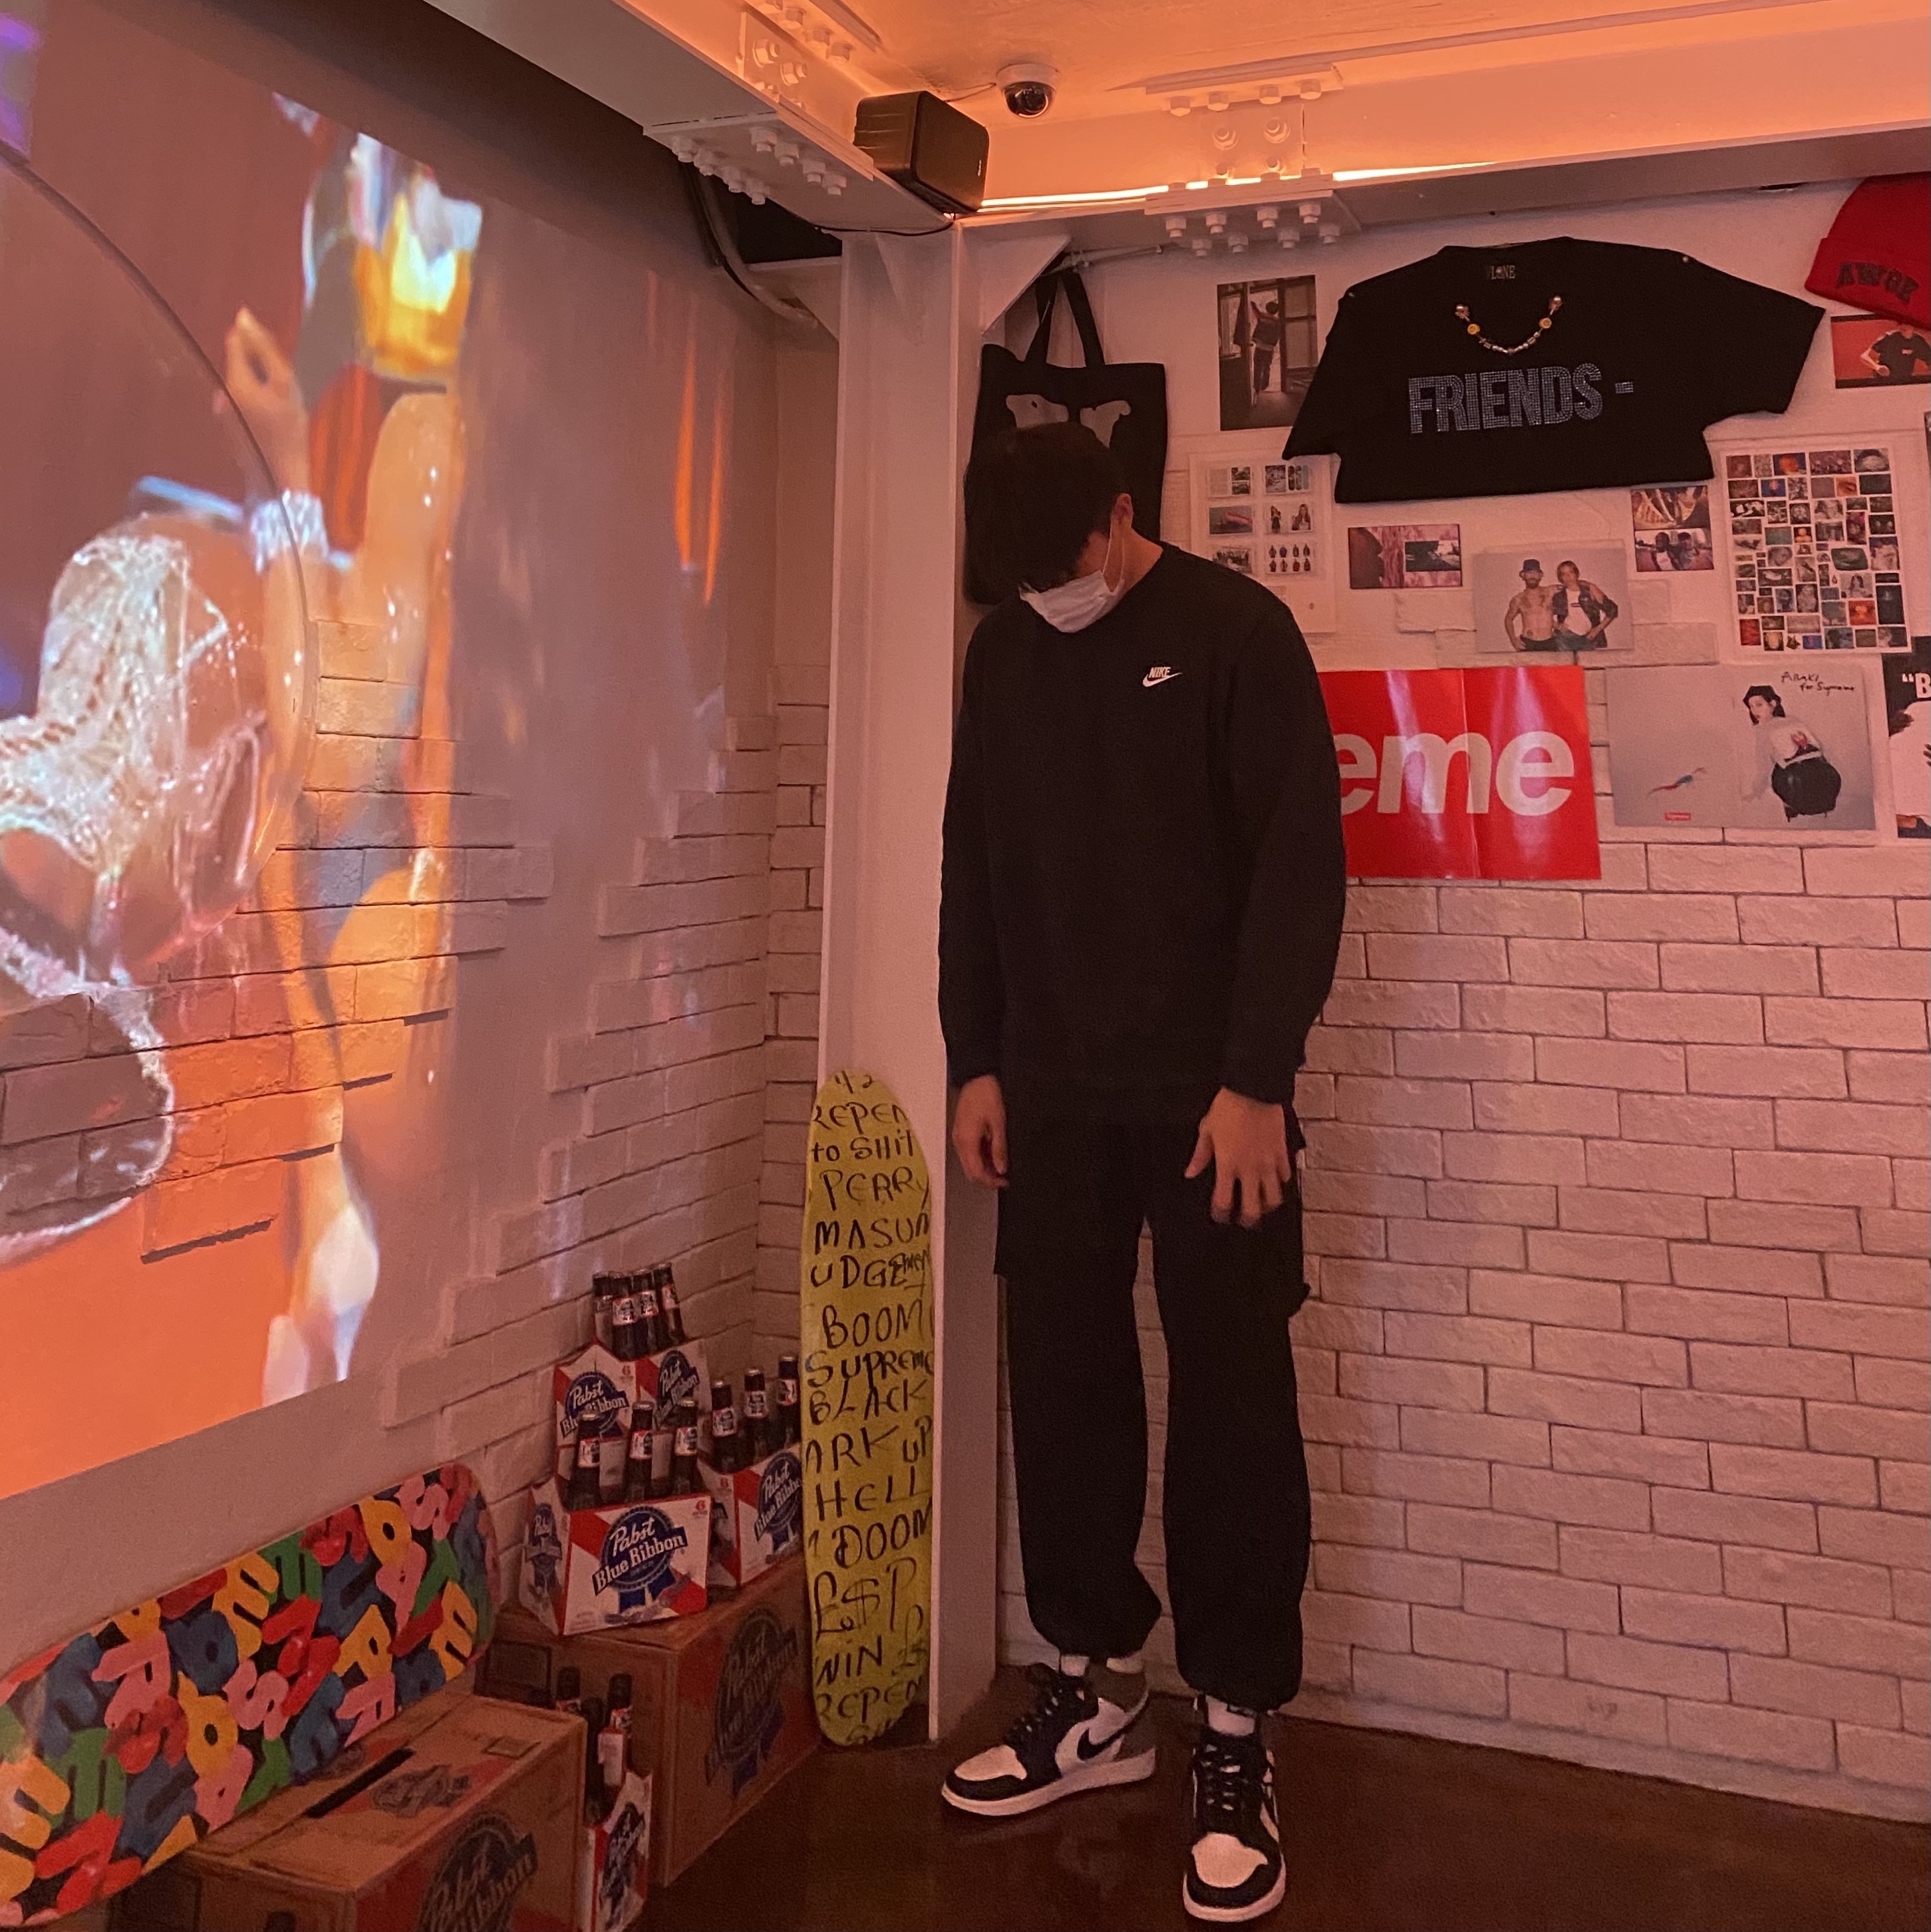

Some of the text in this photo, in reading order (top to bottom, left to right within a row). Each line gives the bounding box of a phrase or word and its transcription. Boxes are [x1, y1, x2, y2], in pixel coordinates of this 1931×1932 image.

[1408, 363, 1603, 434] FRIENDS
[1148, 667, 1171, 678] NIKE
[811, 1142, 840, 1163] to
[569, 1379, 603, 1410] Pabst
[809, 1378, 928, 1426] BLACK
[609, 1516, 658, 1557] Pabst
[593, 1534, 685, 1592] Blue Ribbon
